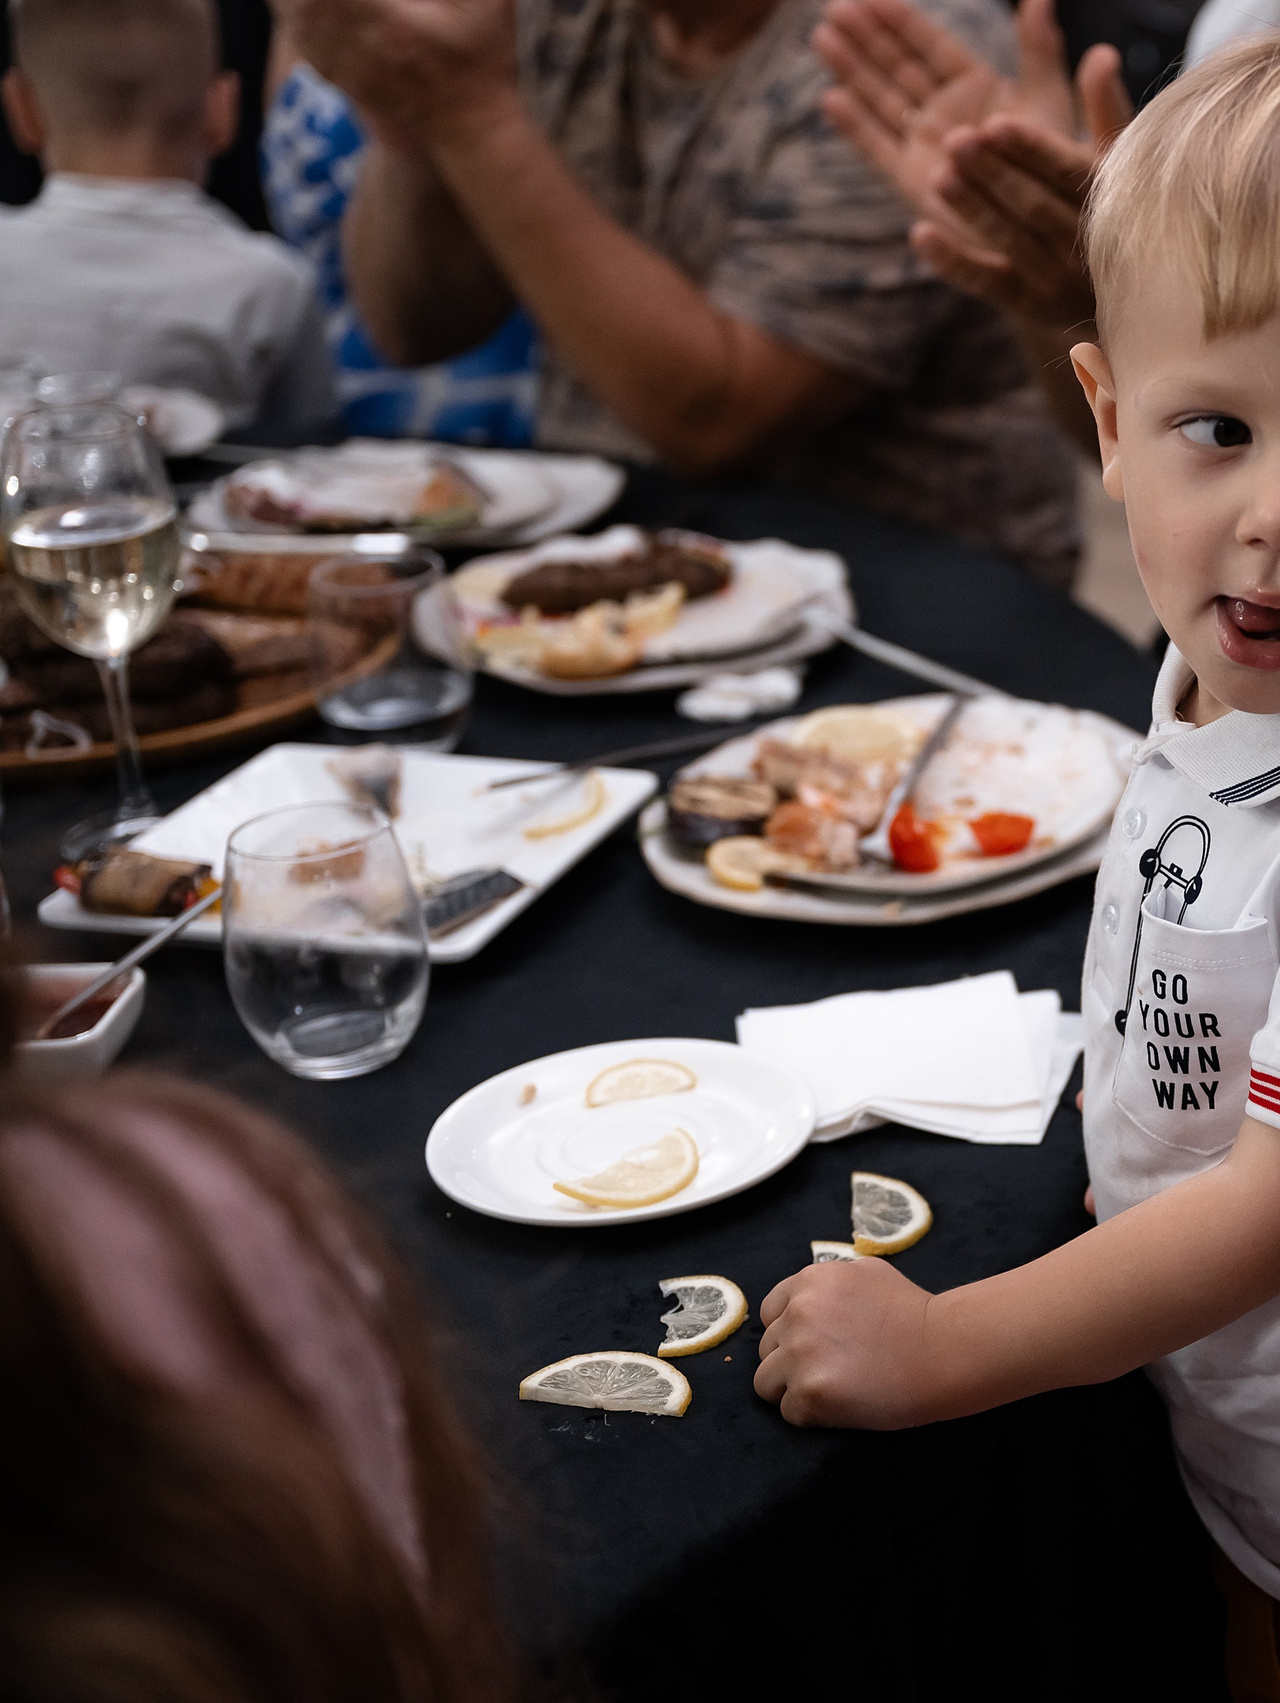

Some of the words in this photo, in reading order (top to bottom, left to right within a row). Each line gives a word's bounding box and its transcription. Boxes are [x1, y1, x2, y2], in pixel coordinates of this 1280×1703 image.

[1152, 969, 1188, 1005] GO
[1139, 999, 1222, 1038] YOUR
[1146, 1041, 1221, 1074] OWN
[1152, 1078, 1219, 1110] WAY
